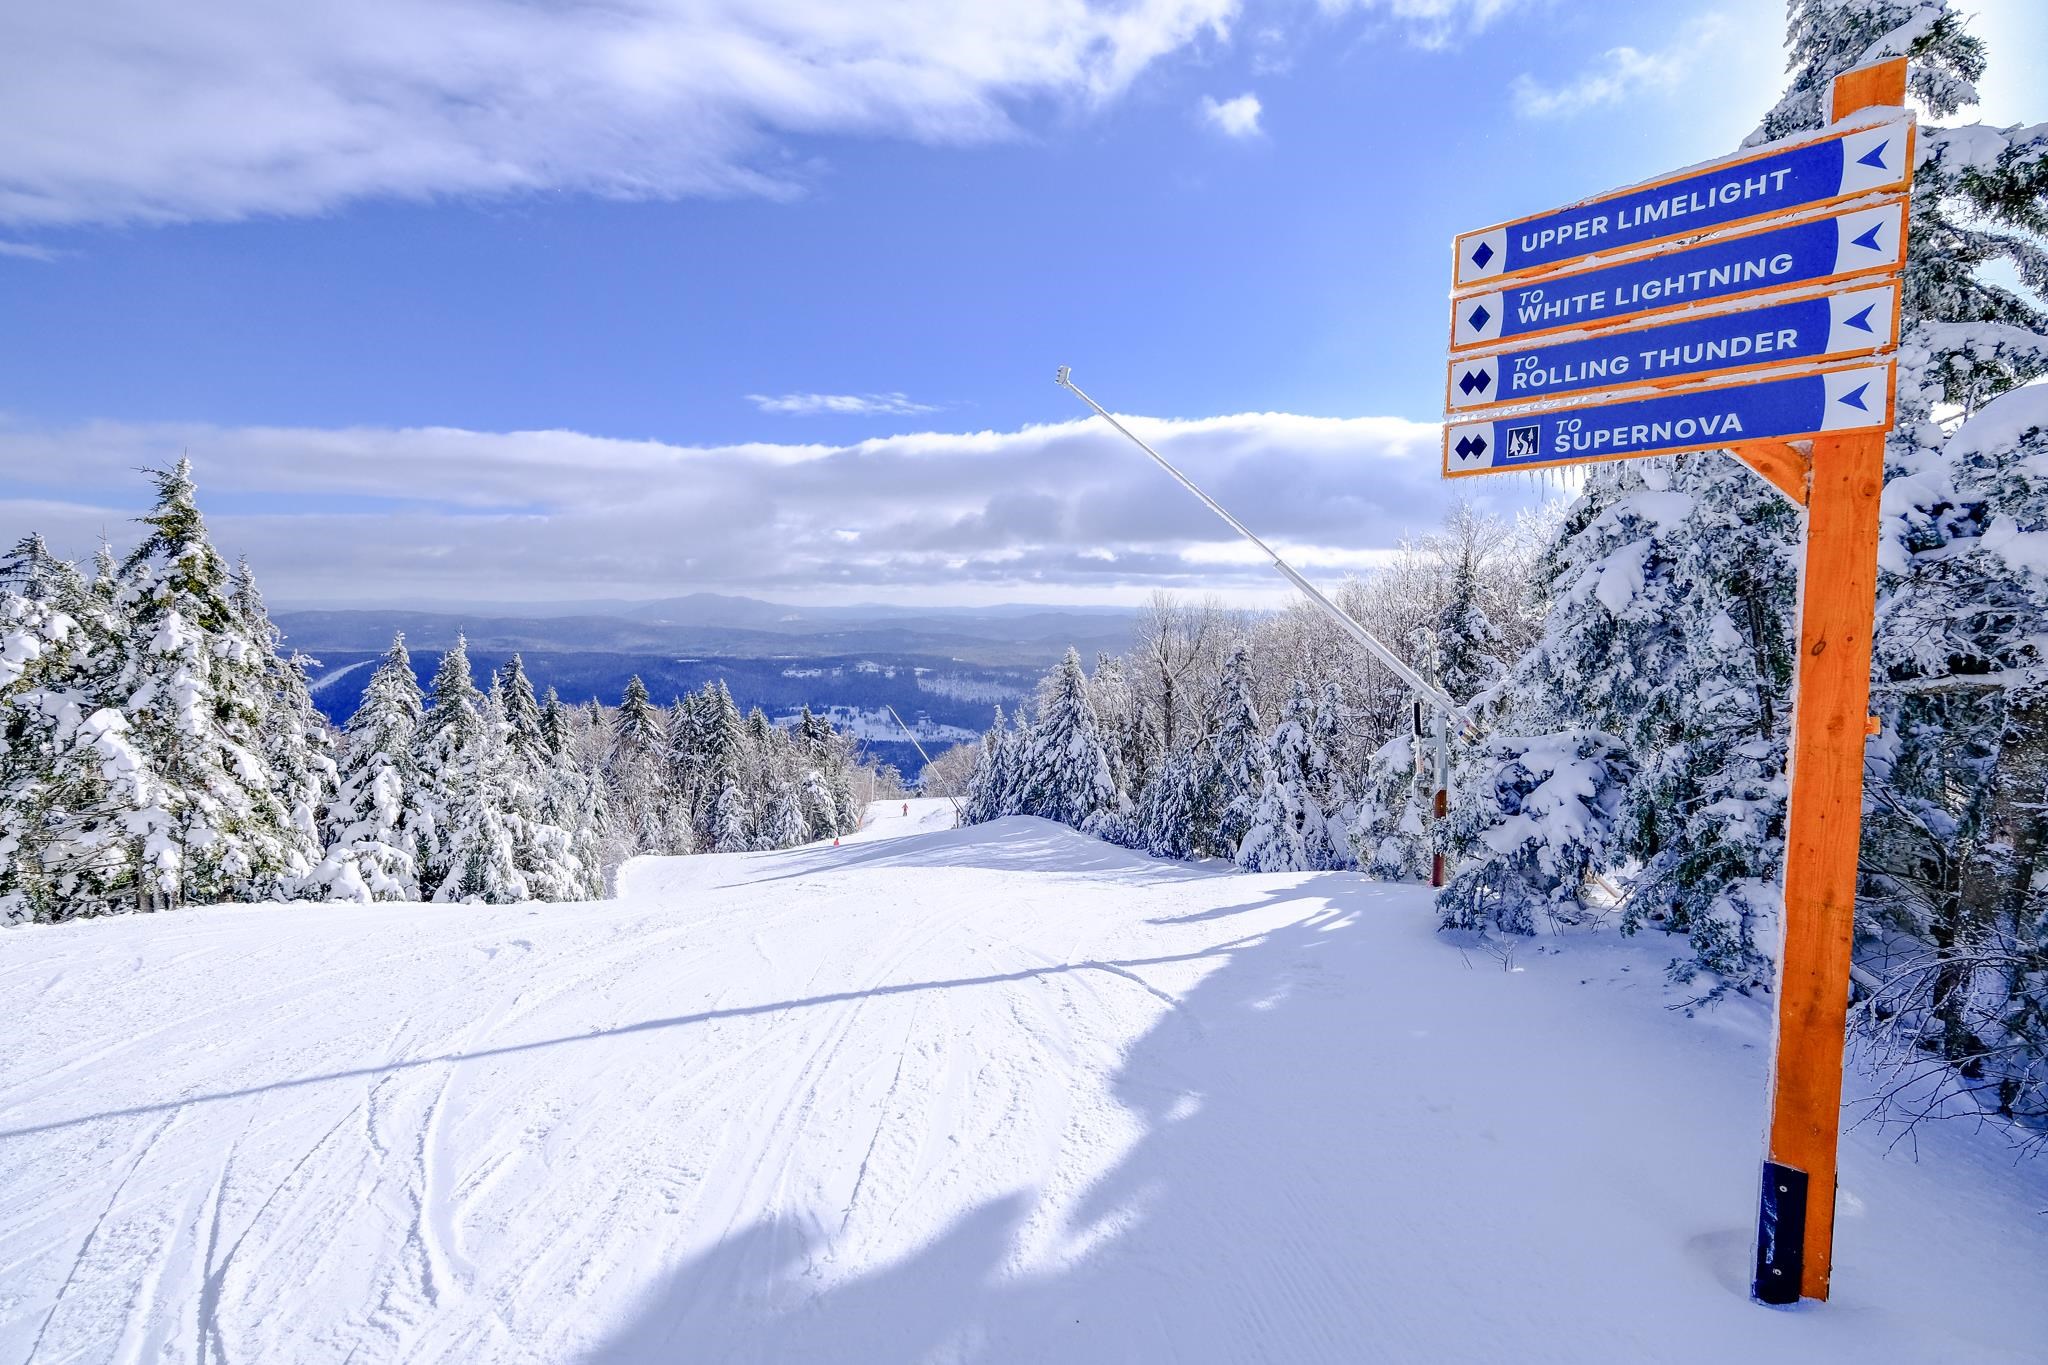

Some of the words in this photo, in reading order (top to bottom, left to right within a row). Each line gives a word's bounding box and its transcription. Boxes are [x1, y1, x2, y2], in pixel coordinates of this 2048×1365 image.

[1522, 215, 1608, 254] UPPER
[1618, 168, 1792, 230] LIMELIGHT
[1518, 291, 1605, 324] WHITE
[1616, 254, 1793, 306] LIGHTNING
[1520, 289, 1543, 306] TO
[1513, 356, 1629, 390] ROLLING
[1640, 330, 1797, 370] THUNDER
[1515, 356, 1538, 372] TO
[1555, 414, 1743, 453] SUPERNOVA
[1556, 419, 1582, 434] TO
